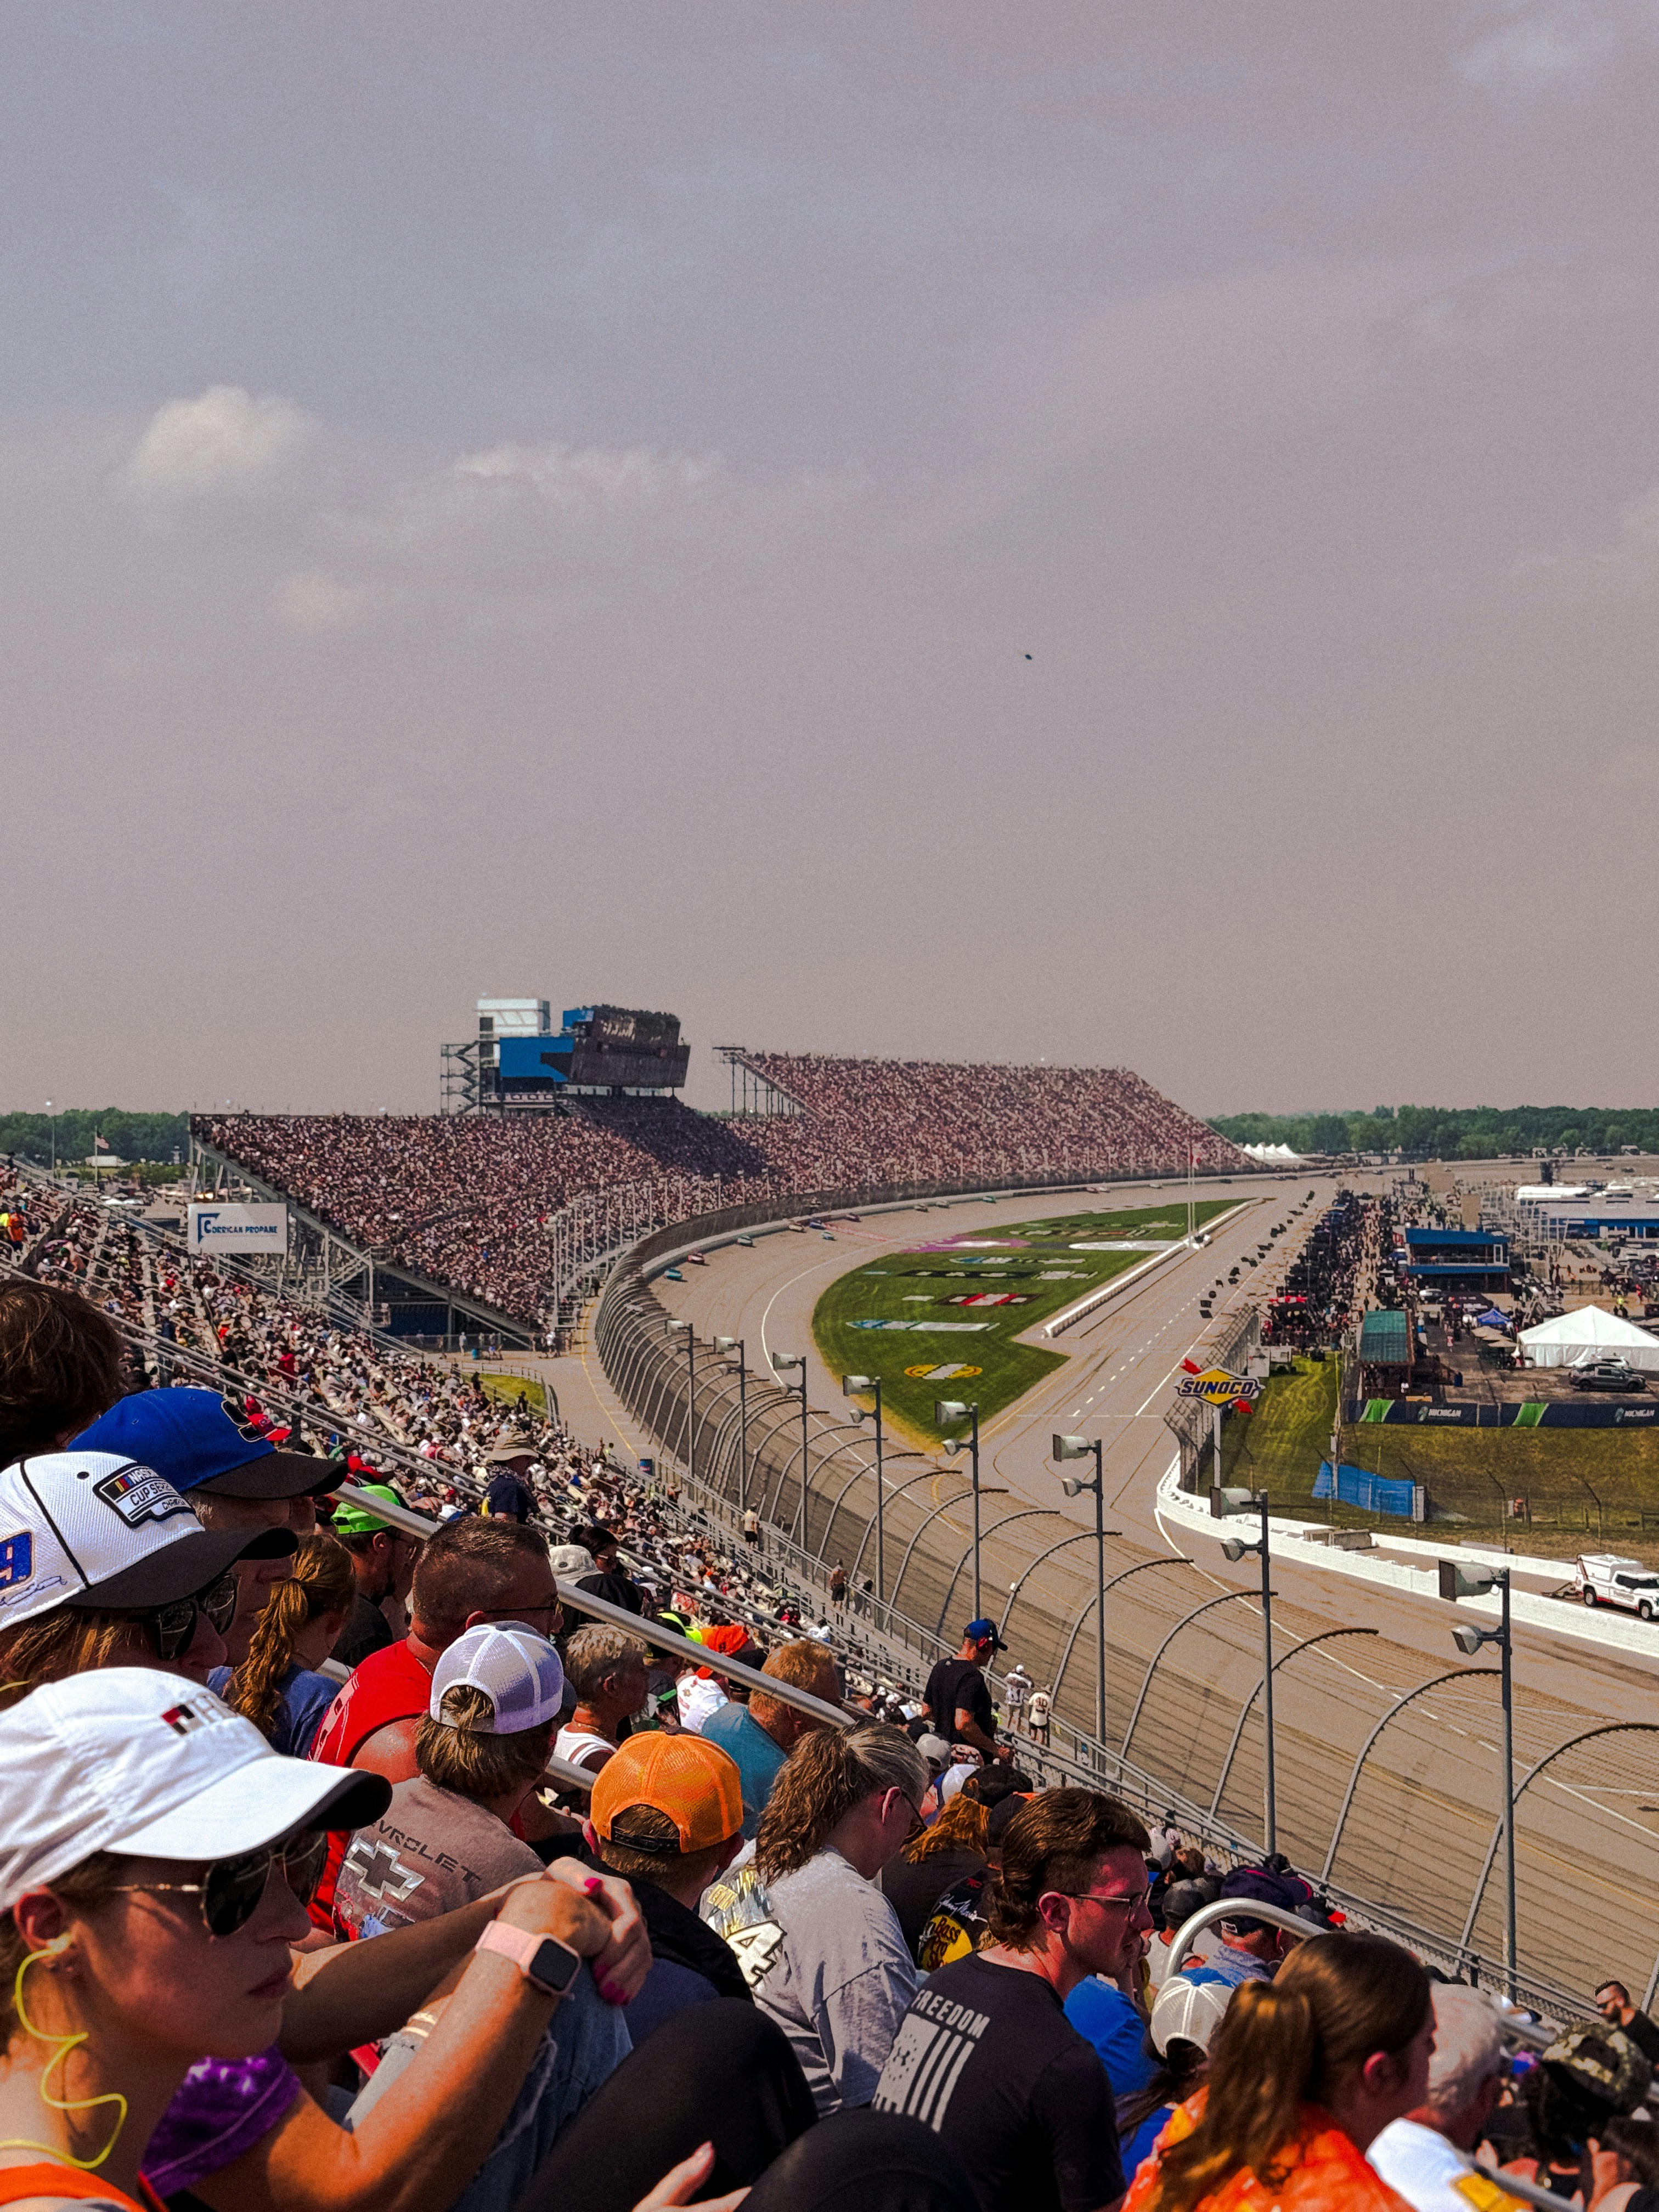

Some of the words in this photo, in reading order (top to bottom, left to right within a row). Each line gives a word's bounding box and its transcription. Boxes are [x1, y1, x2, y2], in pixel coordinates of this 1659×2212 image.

[245, 1225, 278, 1234] PROPANE
[1181, 1380, 1254, 1395] SUNOCO
[129, 1487, 151, 1506] CUP
[371, 1819, 482, 1883] VROLET
[934, 1916, 961, 1944] Bass
[724, 1920, 787, 1987] 4
[911, 1989, 991, 2039] FREEDOM
